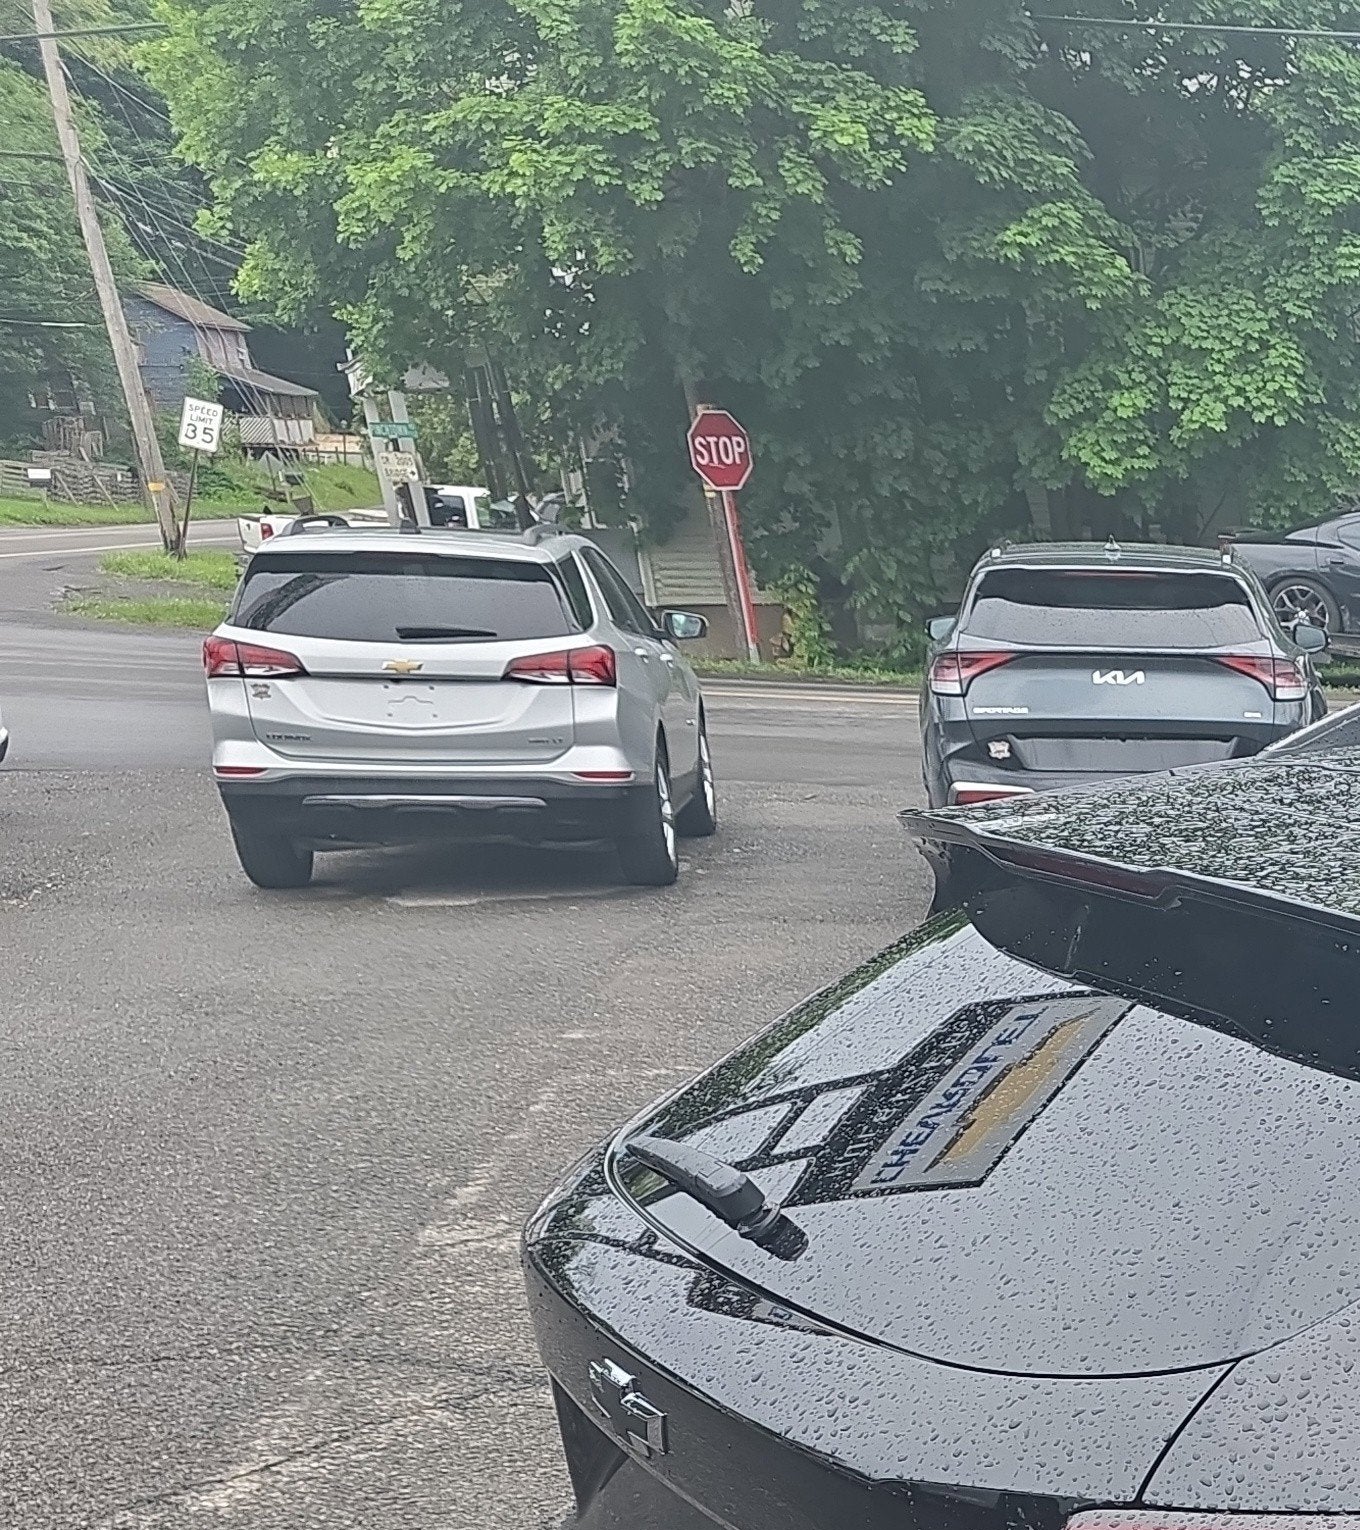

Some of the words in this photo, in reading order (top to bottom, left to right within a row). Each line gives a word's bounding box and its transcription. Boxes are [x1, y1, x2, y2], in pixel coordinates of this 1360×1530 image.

[188, 404, 218, 417] SPEED
[190, 414, 213, 425] LIMIT
[185, 423, 214, 443] 35
[694, 436, 745, 465] STOP
[1092, 670, 1145, 684] KIA
